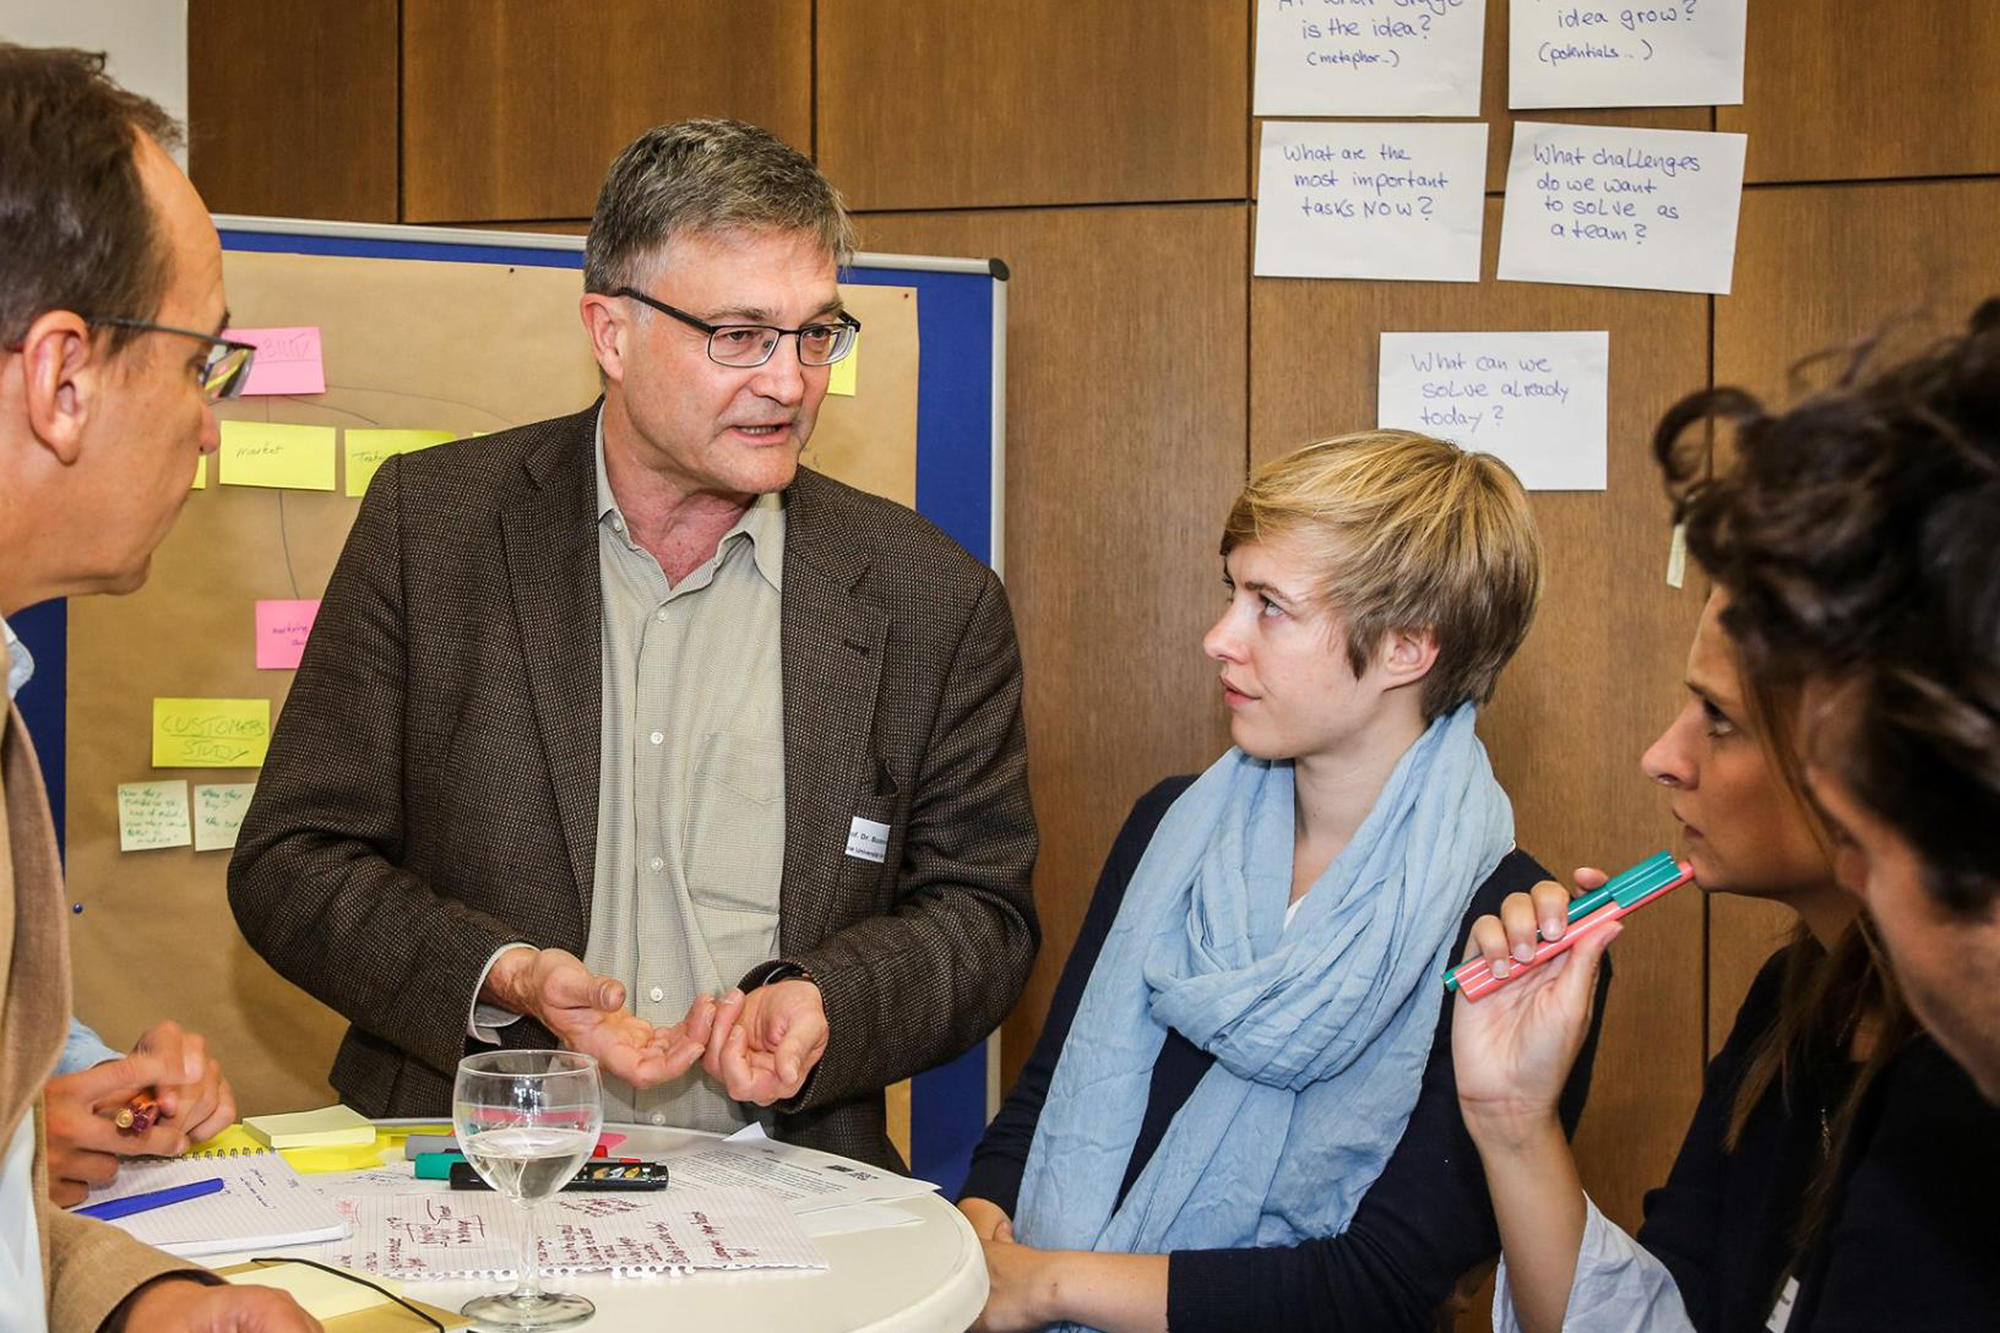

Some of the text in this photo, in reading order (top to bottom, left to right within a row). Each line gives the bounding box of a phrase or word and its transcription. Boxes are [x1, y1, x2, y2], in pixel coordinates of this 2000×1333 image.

[1302, 14, 1432, 40] is the idea?
[1558, 9, 1608, 28] idea
[1284, 144, 1412, 162] What are the
[1534, 144, 1701, 177] What challenges
[1294, 170, 1449, 196] most important
[1537, 173, 1657, 194] do we want
[1544, 196, 1563, 212] to
[1657, 204, 1680, 219] as
[1551, 222, 1564, 239] a
[1411, 352, 1552, 372] What can we
[1501, 380, 1569, 404] already
